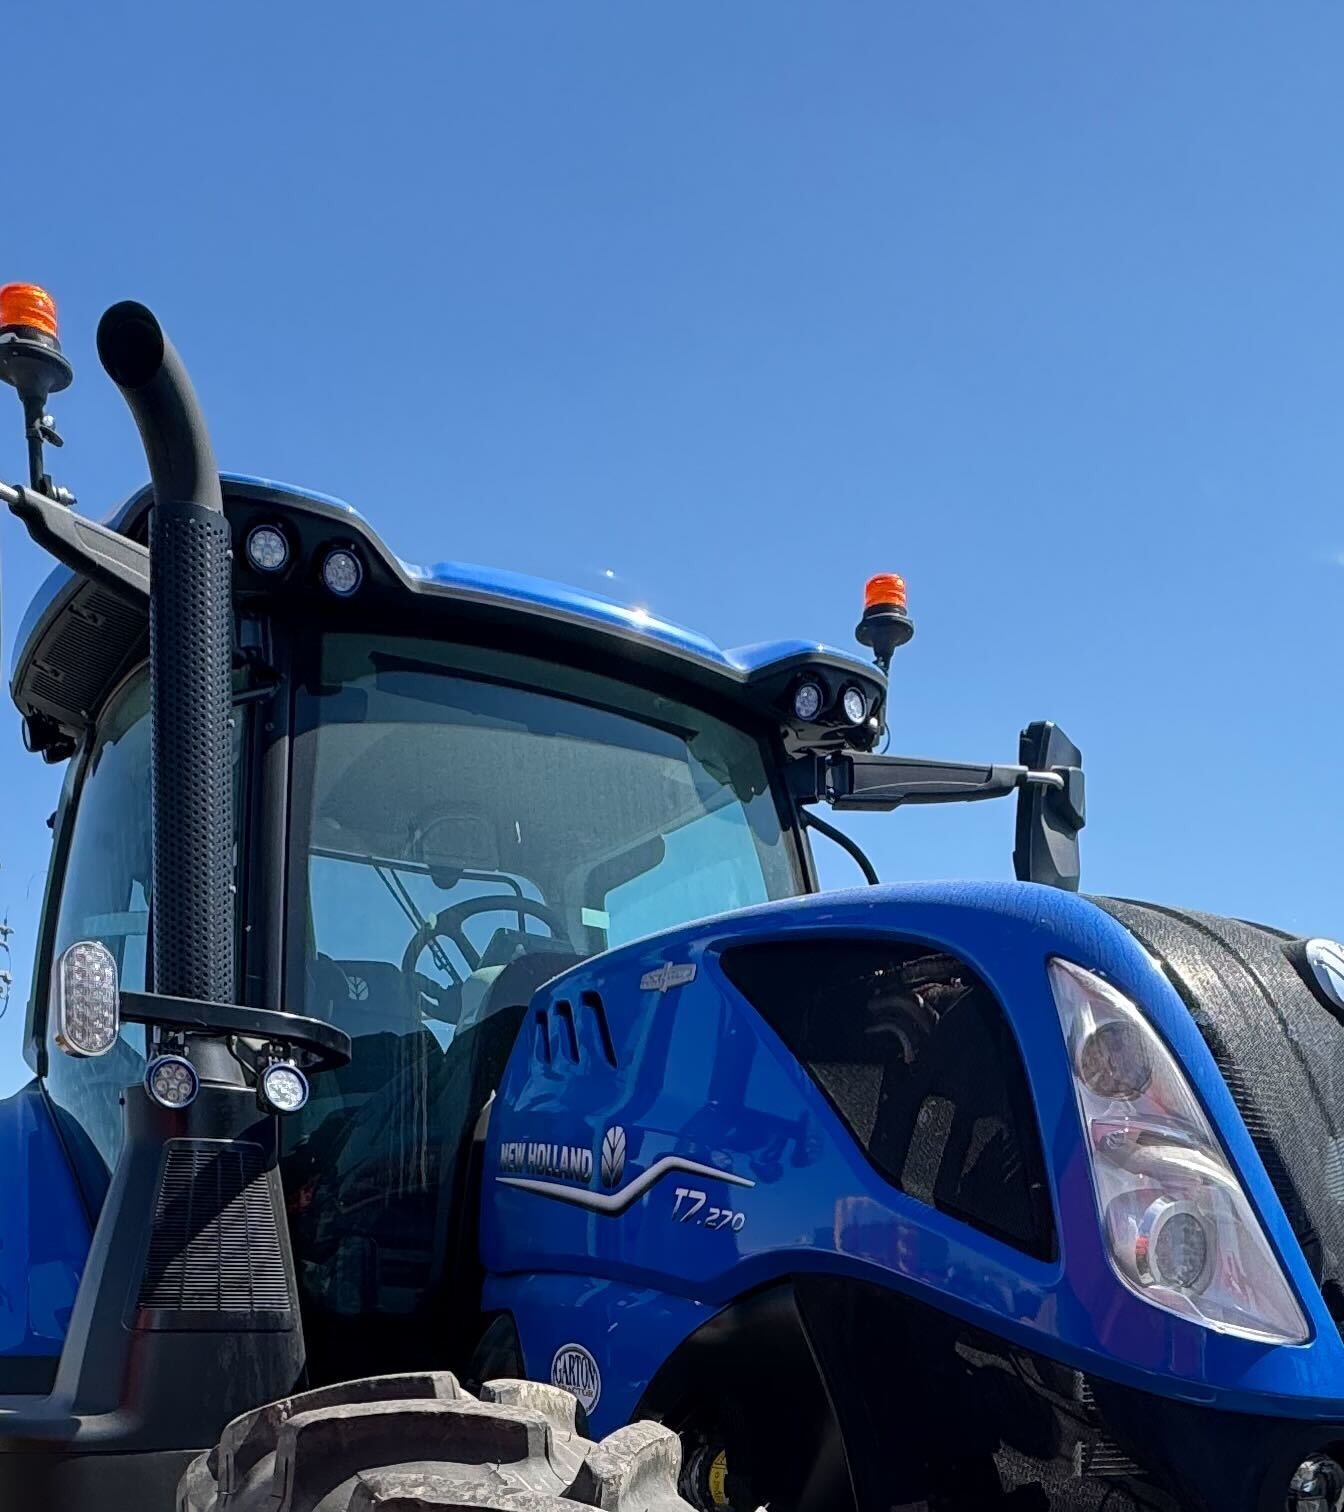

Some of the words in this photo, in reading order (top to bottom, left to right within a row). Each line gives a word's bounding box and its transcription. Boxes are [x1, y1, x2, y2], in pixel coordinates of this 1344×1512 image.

[501, 1142, 527, 1171] NEW
[528, 1142, 594, 1185] HOLLAND
[672, 1187, 746, 1231] T7.270
[554, 1352, 596, 1390] GARTON
